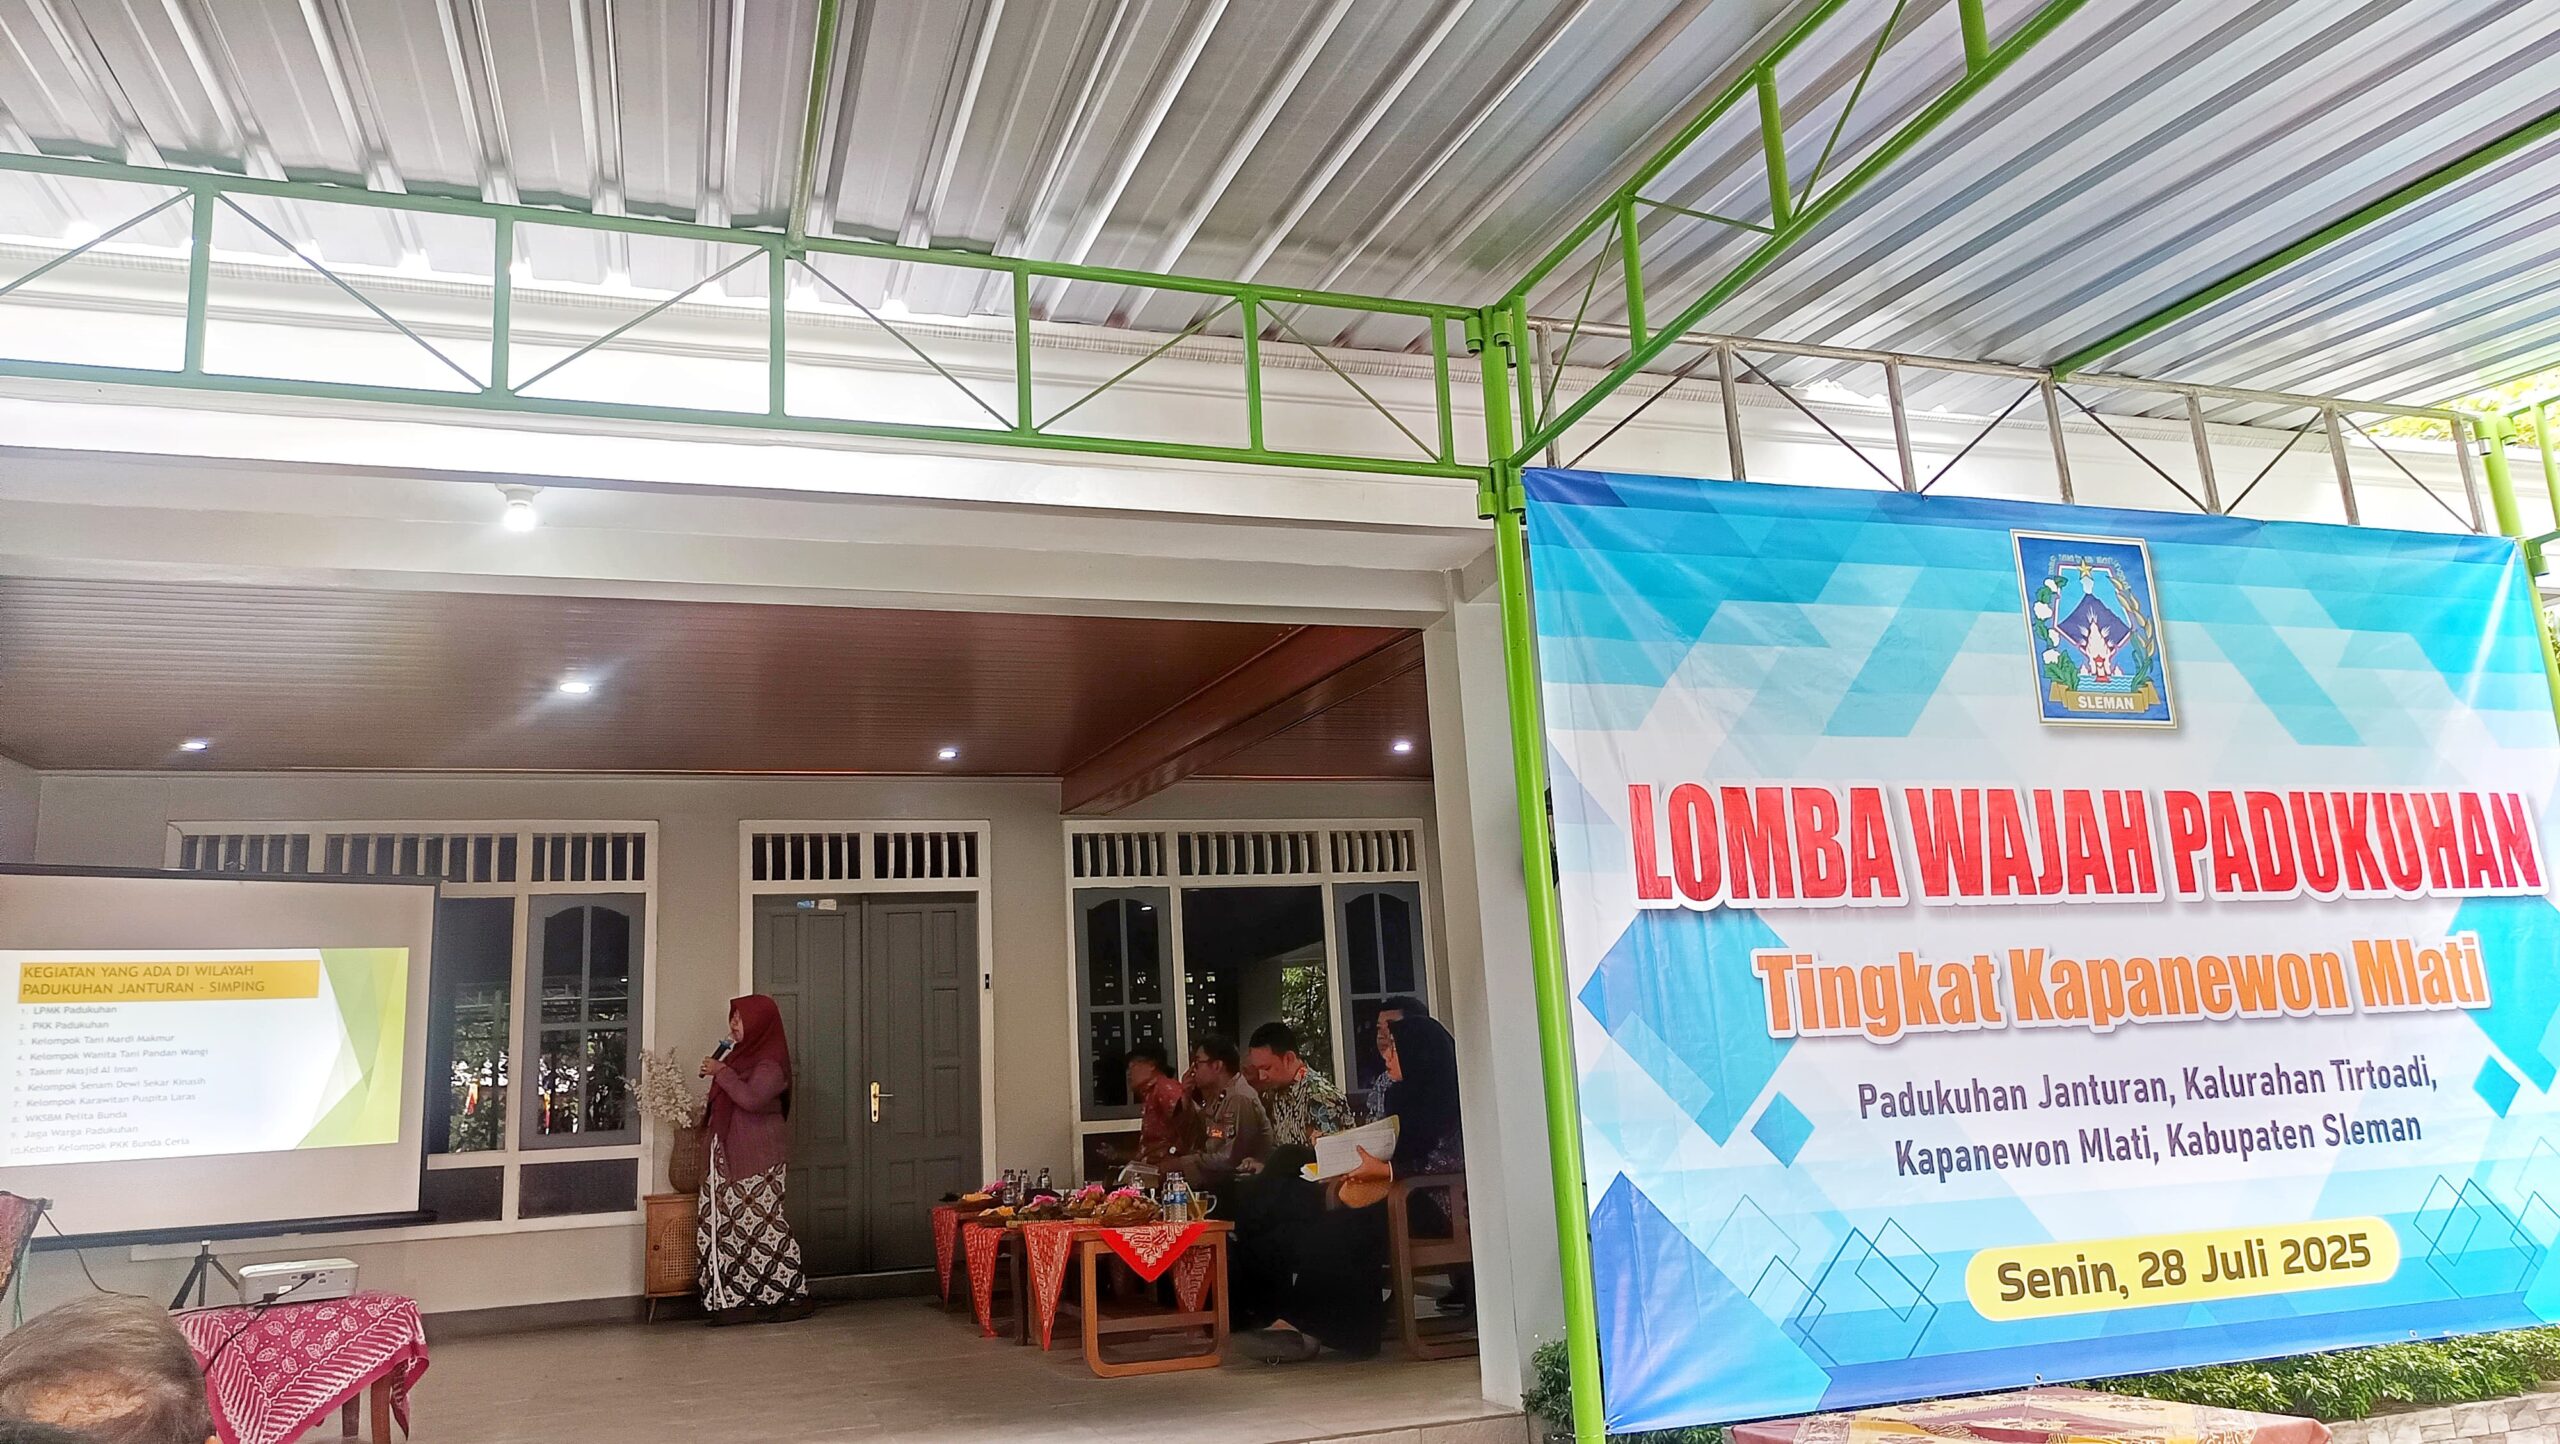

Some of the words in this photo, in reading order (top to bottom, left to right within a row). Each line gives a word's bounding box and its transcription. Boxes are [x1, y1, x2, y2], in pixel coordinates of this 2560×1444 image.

[2078, 695, 2134, 710] SLEMAN
[1628, 783, 1902, 902] LOMBA
[1904, 787, 2159, 897] WAJAH
[2164, 789, 2542, 894] PADUKUHAN
[23, 966, 96, 979] KEGIATAN
[101, 966, 139, 978] YANG
[143, 966, 172, 977] ADA
[176, 965, 190, 977] DI
[194, 965, 254, 976] WILAYAH
[22, 983, 113, 995] PADUKUHAN
[118, 982, 194, 994] JANTURAN
[209, 981, 265, 993] SIMPING
[1757, 951, 2001, 1037] Tingkat
[2008, 947, 2349, 1027] Kapanewon
[2351, 936, 2486, 1007] Mlati
[33, 1006, 61, 1015] LPMK
[64, 1006, 118, 1014] Padukuhan
[32, 1022, 53, 1030] PKK
[55, 1021, 109, 1030] Padukuhan
[31, 1037, 80, 1046] Kelompok
[84, 1036, 104, 1044] Tani
[107, 1035, 134, 1044] Mardi
[137, 1034, 176, 1043] Makmur
[30, 1052, 80, 1061] Kelompok
[83, 1051, 117, 1060] Wanita
[120, 1050, 140, 1058] Tani
[142, 1049, 177, 1058] Pandan
[180, 1047, 209, 1058] Wangi
[29, 1067, 62, 1076] Takmir
[66, 1066, 98, 1076] Masjid
[114, 1065, 138, 1074] Iman
[27, 1083, 77, 1092] Kelompok
[80, 1081, 113, 1090] Senam
[143, 1079, 169, 1088] Sekar
[1858, 1078, 2028, 1119] Padukuhan
[2038, 1074, 2176, 1109] Janturan,
[2182, 1062, 2326, 1101] Kalurahan
[2329, 1055, 2438, 1093] Tirtoadi,
[26, 1099, 76, 1107] Kelompok
[80, 1096, 129, 1105] Karawitan
[171, 1093, 196, 1102] Laras
[97, 1111, 128, 1120] Bunda
[24, 1130, 48, 1139] Jaga
[51, 1128, 82, 1138] Warga
[85, 1126, 139, 1135] Padukuhan
[58, 1143, 106, 1152] Kelompok
[132, 1139, 162, 1148] Bunda
[1895, 1138, 2070, 1184] Kapanewon
[2078, 1125, 2159, 1166] Mlati,
[2166, 1120, 2316, 1162] Kabupaten
[2322, 1112, 2423, 1147] Sleman
[1997, 1254, 2130, 1302] Senin,
[2137, 1249, 2188, 1289] 28
[2201, 1237, 2269, 1283] Juli
[2279, 1232, 2372, 1275] 2025
